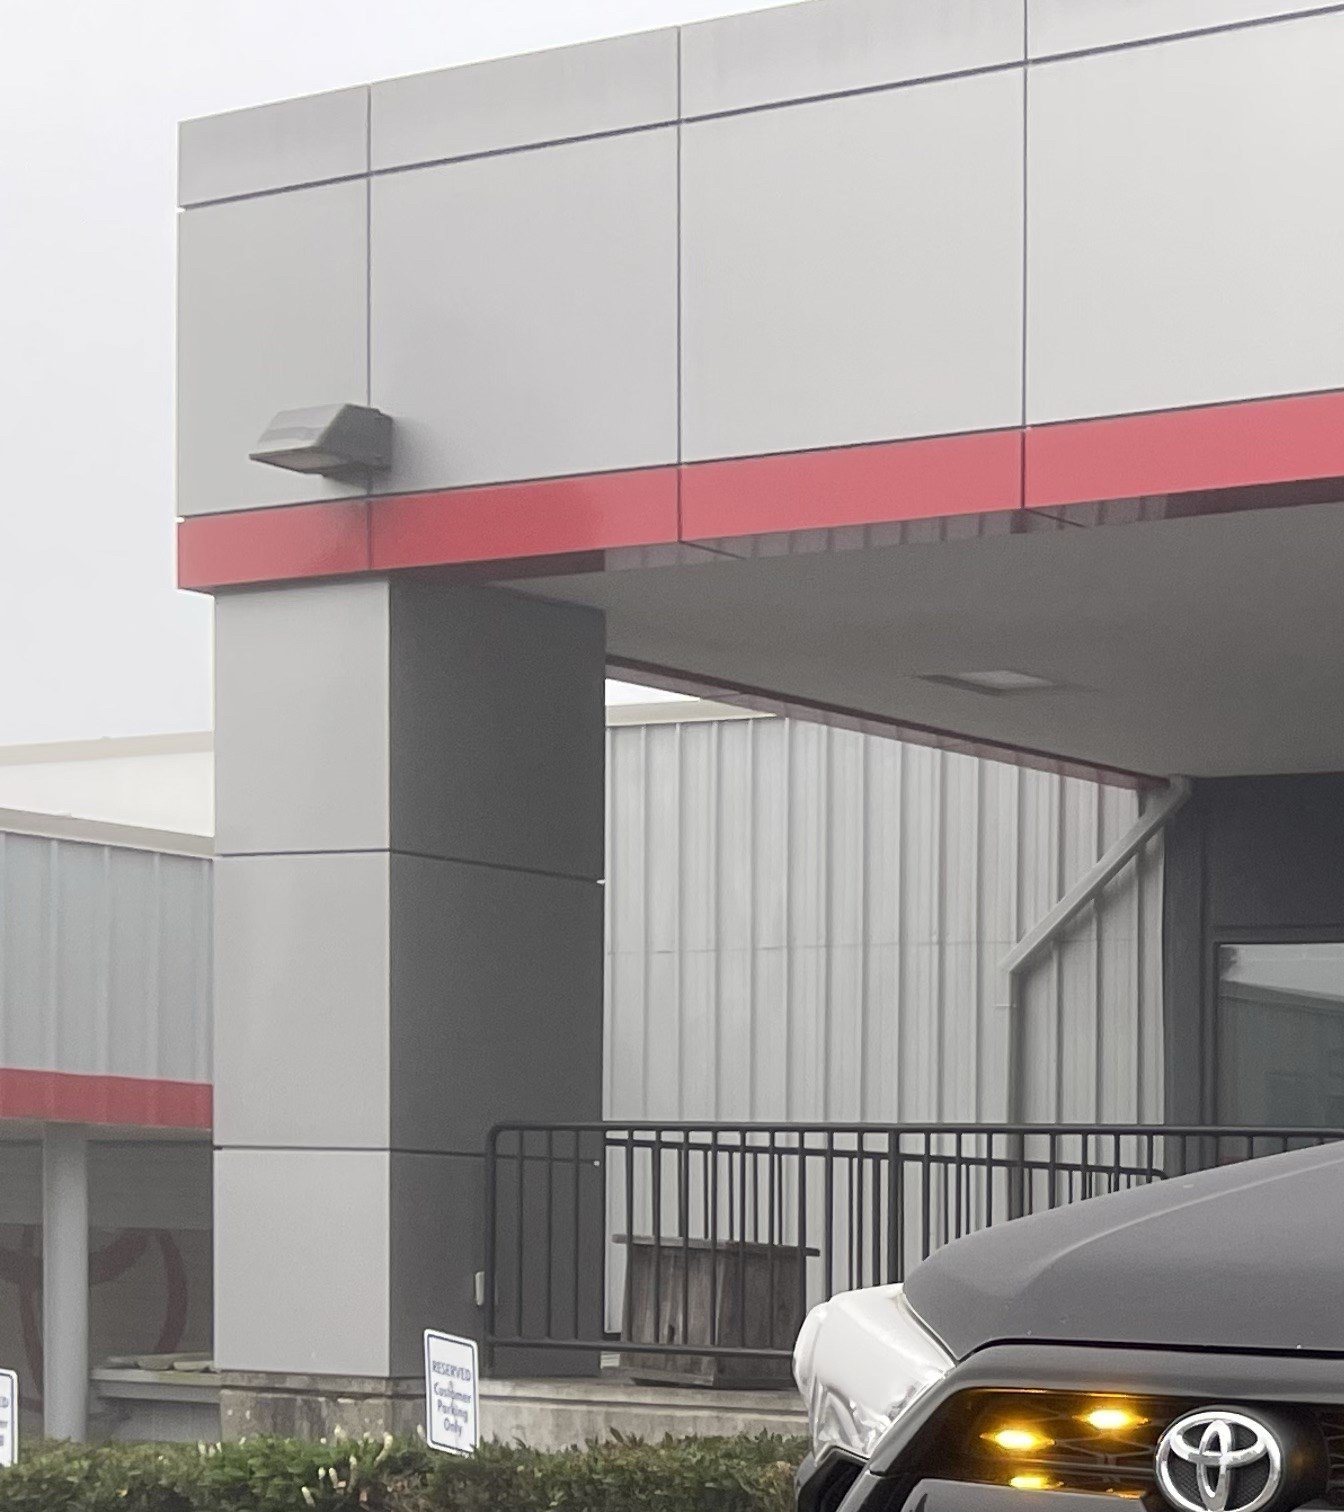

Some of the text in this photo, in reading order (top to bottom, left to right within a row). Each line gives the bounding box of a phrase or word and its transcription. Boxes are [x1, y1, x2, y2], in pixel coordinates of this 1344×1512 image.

[432, 1360, 471, 1382] RESERVED
[437, 1399, 468, 1423] Parking
[443, 1417, 463, 1437] Only
